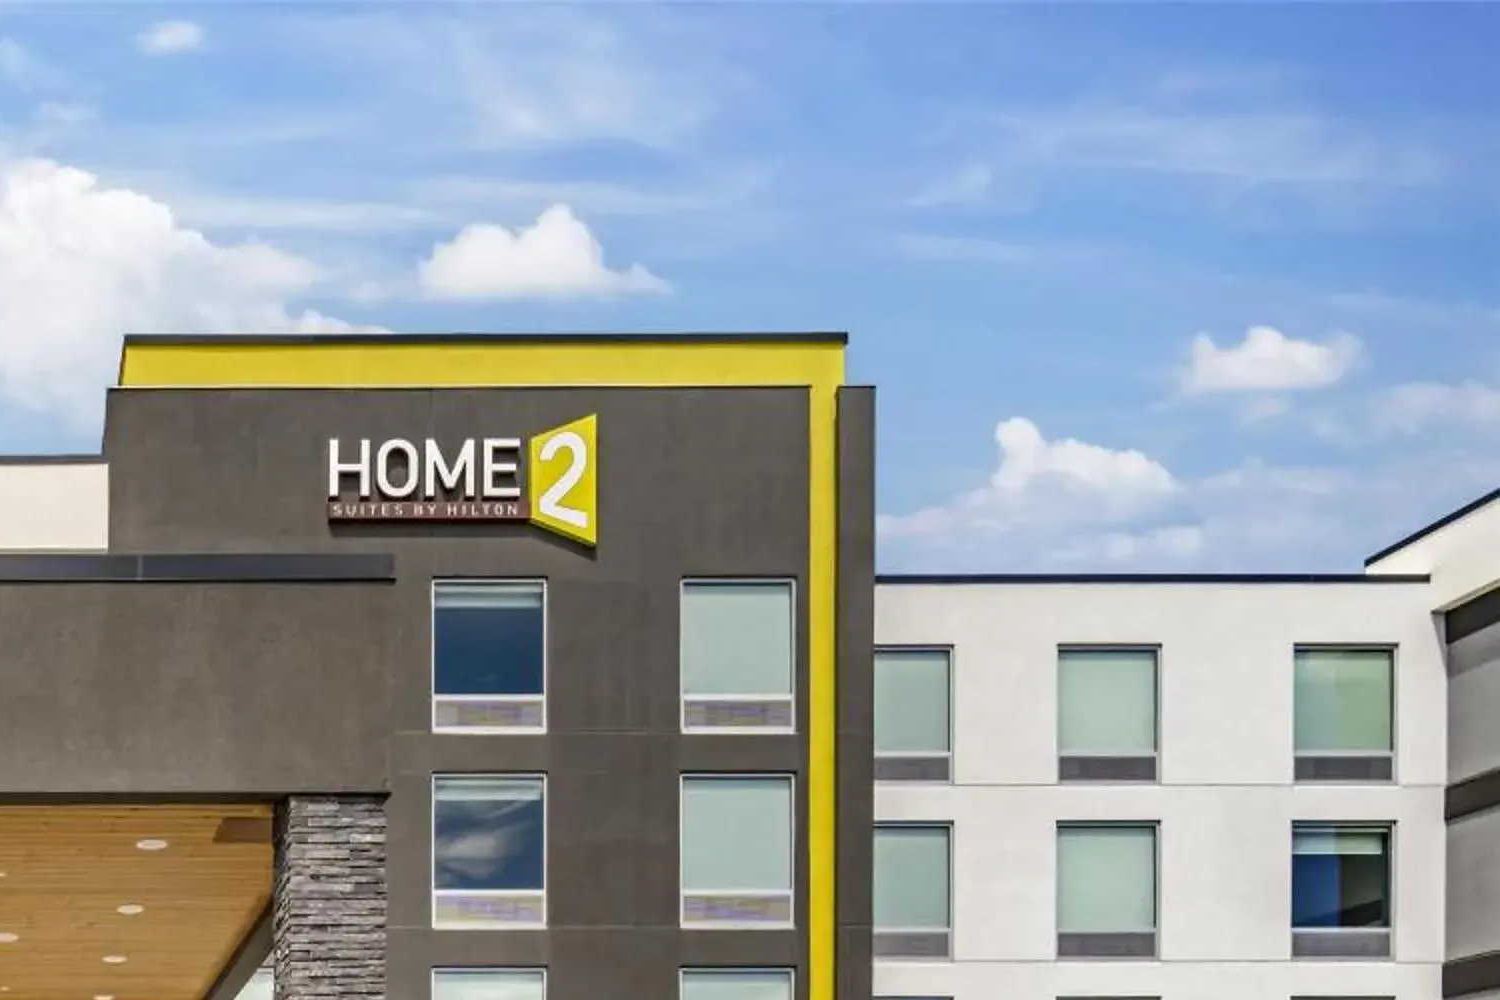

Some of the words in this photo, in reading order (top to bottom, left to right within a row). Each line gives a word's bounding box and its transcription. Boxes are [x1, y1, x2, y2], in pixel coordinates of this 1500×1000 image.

[332, 503, 404, 517] SUITES
[413, 503, 438, 517] BY
[446, 503, 519, 517] HILTON
